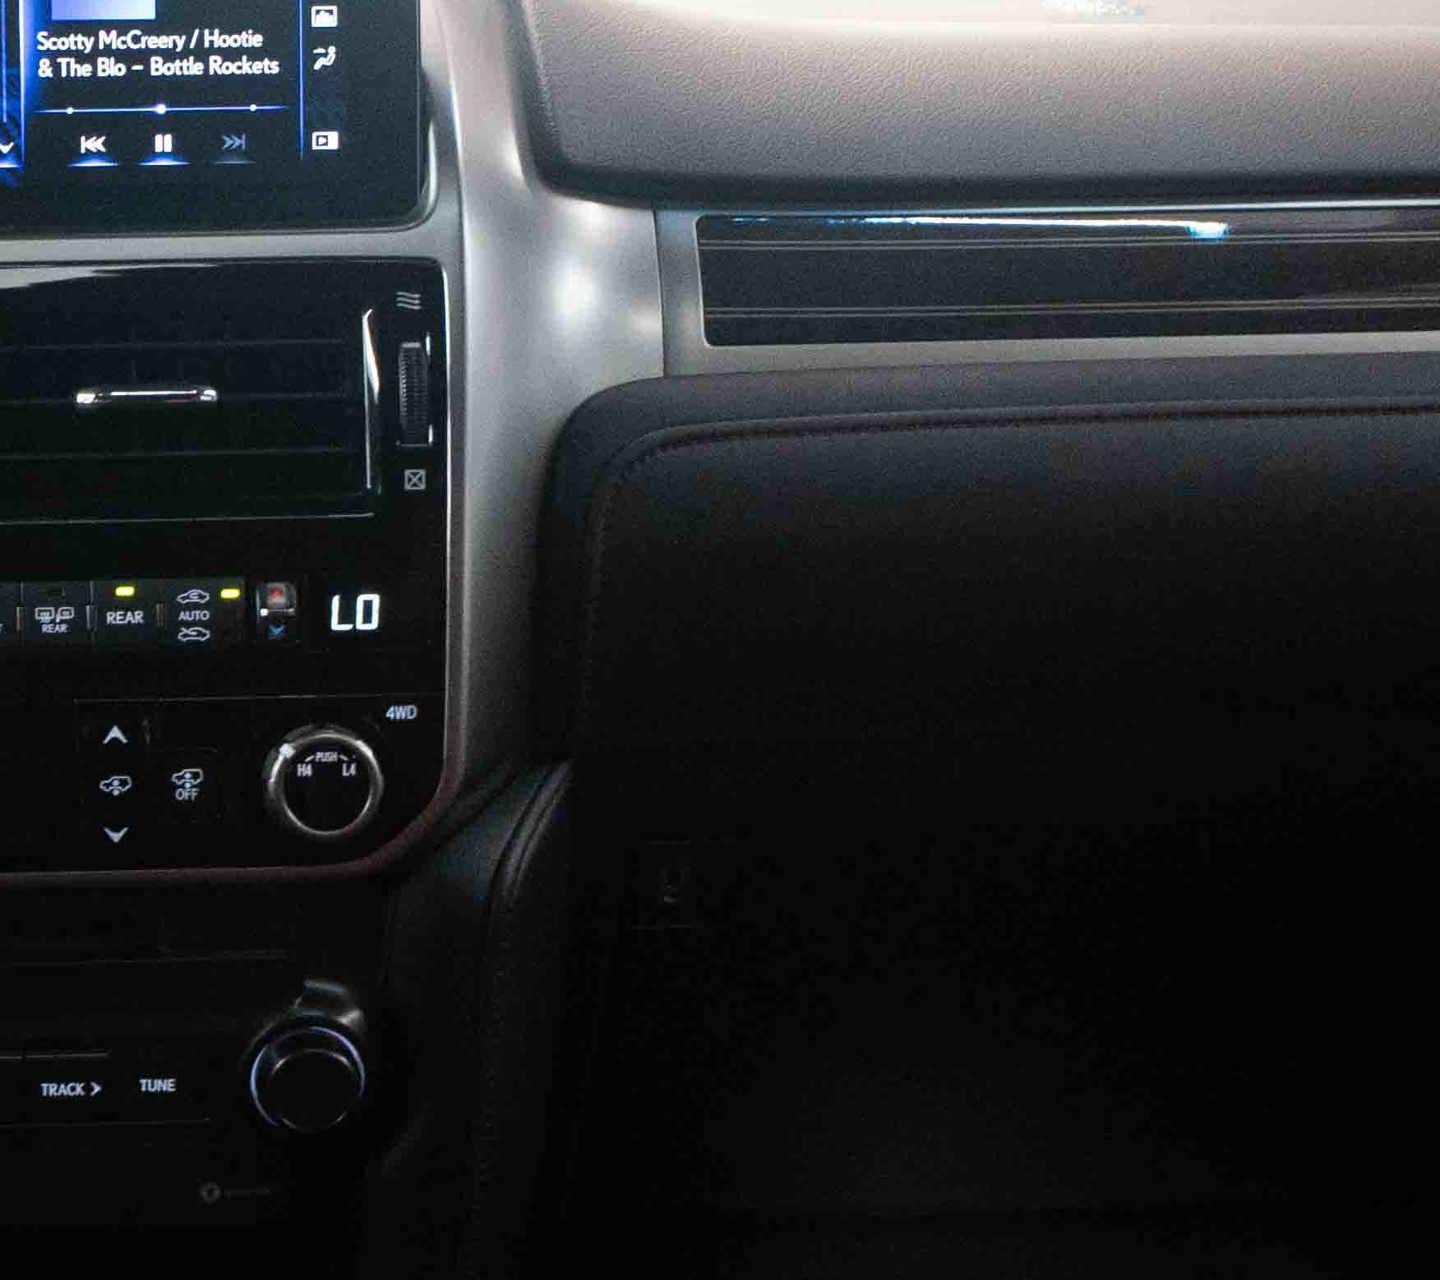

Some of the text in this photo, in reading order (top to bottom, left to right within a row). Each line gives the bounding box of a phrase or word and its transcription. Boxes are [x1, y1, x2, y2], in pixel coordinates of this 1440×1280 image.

[35, 30, 96, 54] Scotty
[98, 28, 186, 53] McCreery
[203, 28, 264, 49] Hootie
[37, 57, 54, 78] &
[57, 56, 93, 78] The
[97, 56, 127, 77] Blo
[149, 55, 205, 77] Bottle
[210, 54, 280, 76] Rockets
[106, 610, 144, 625] REAR
[178, 609, 210, 622] AUTO
[330, 593, 381, 631] LO
[41, 623, 69, 634] REAR
[385, 704, 418, 720] 4WD
[341, 763, 356, 777] L4
[175, 787, 199, 801] OFF
[40, 1082, 85, 1097] TRACK
[139, 1078, 177, 1093] TUNE
